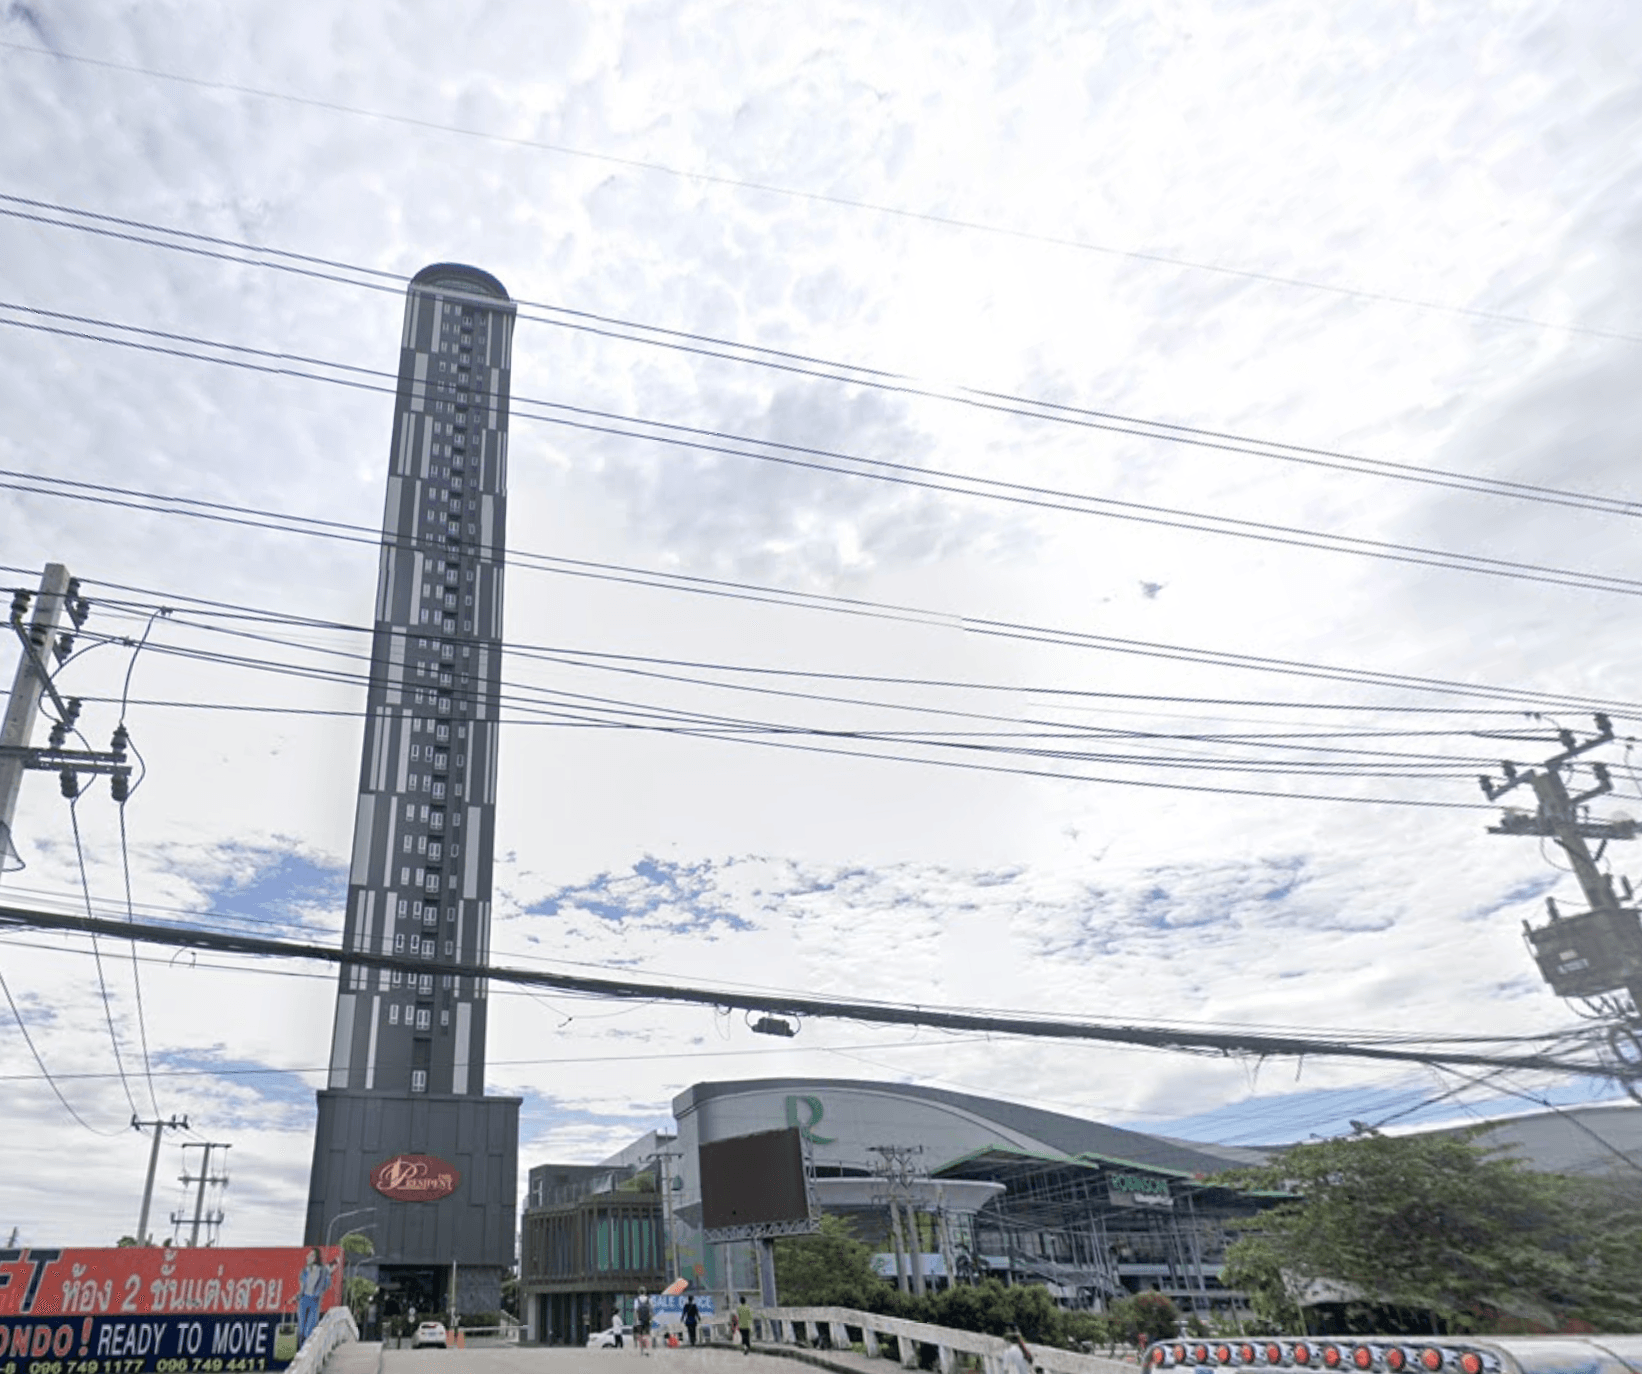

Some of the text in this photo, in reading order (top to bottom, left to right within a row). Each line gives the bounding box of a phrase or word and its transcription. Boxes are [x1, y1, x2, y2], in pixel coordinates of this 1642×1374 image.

[61, 1262, 113, 1313] ห้อง
[121, 1273, 141, 1312] 2
[97, 1322, 167, 1356] READY
[177, 1322, 202, 1354] TO
[211, 1322, 269, 1354] MOVE
[226, 1357, 265, 1371] 4411
